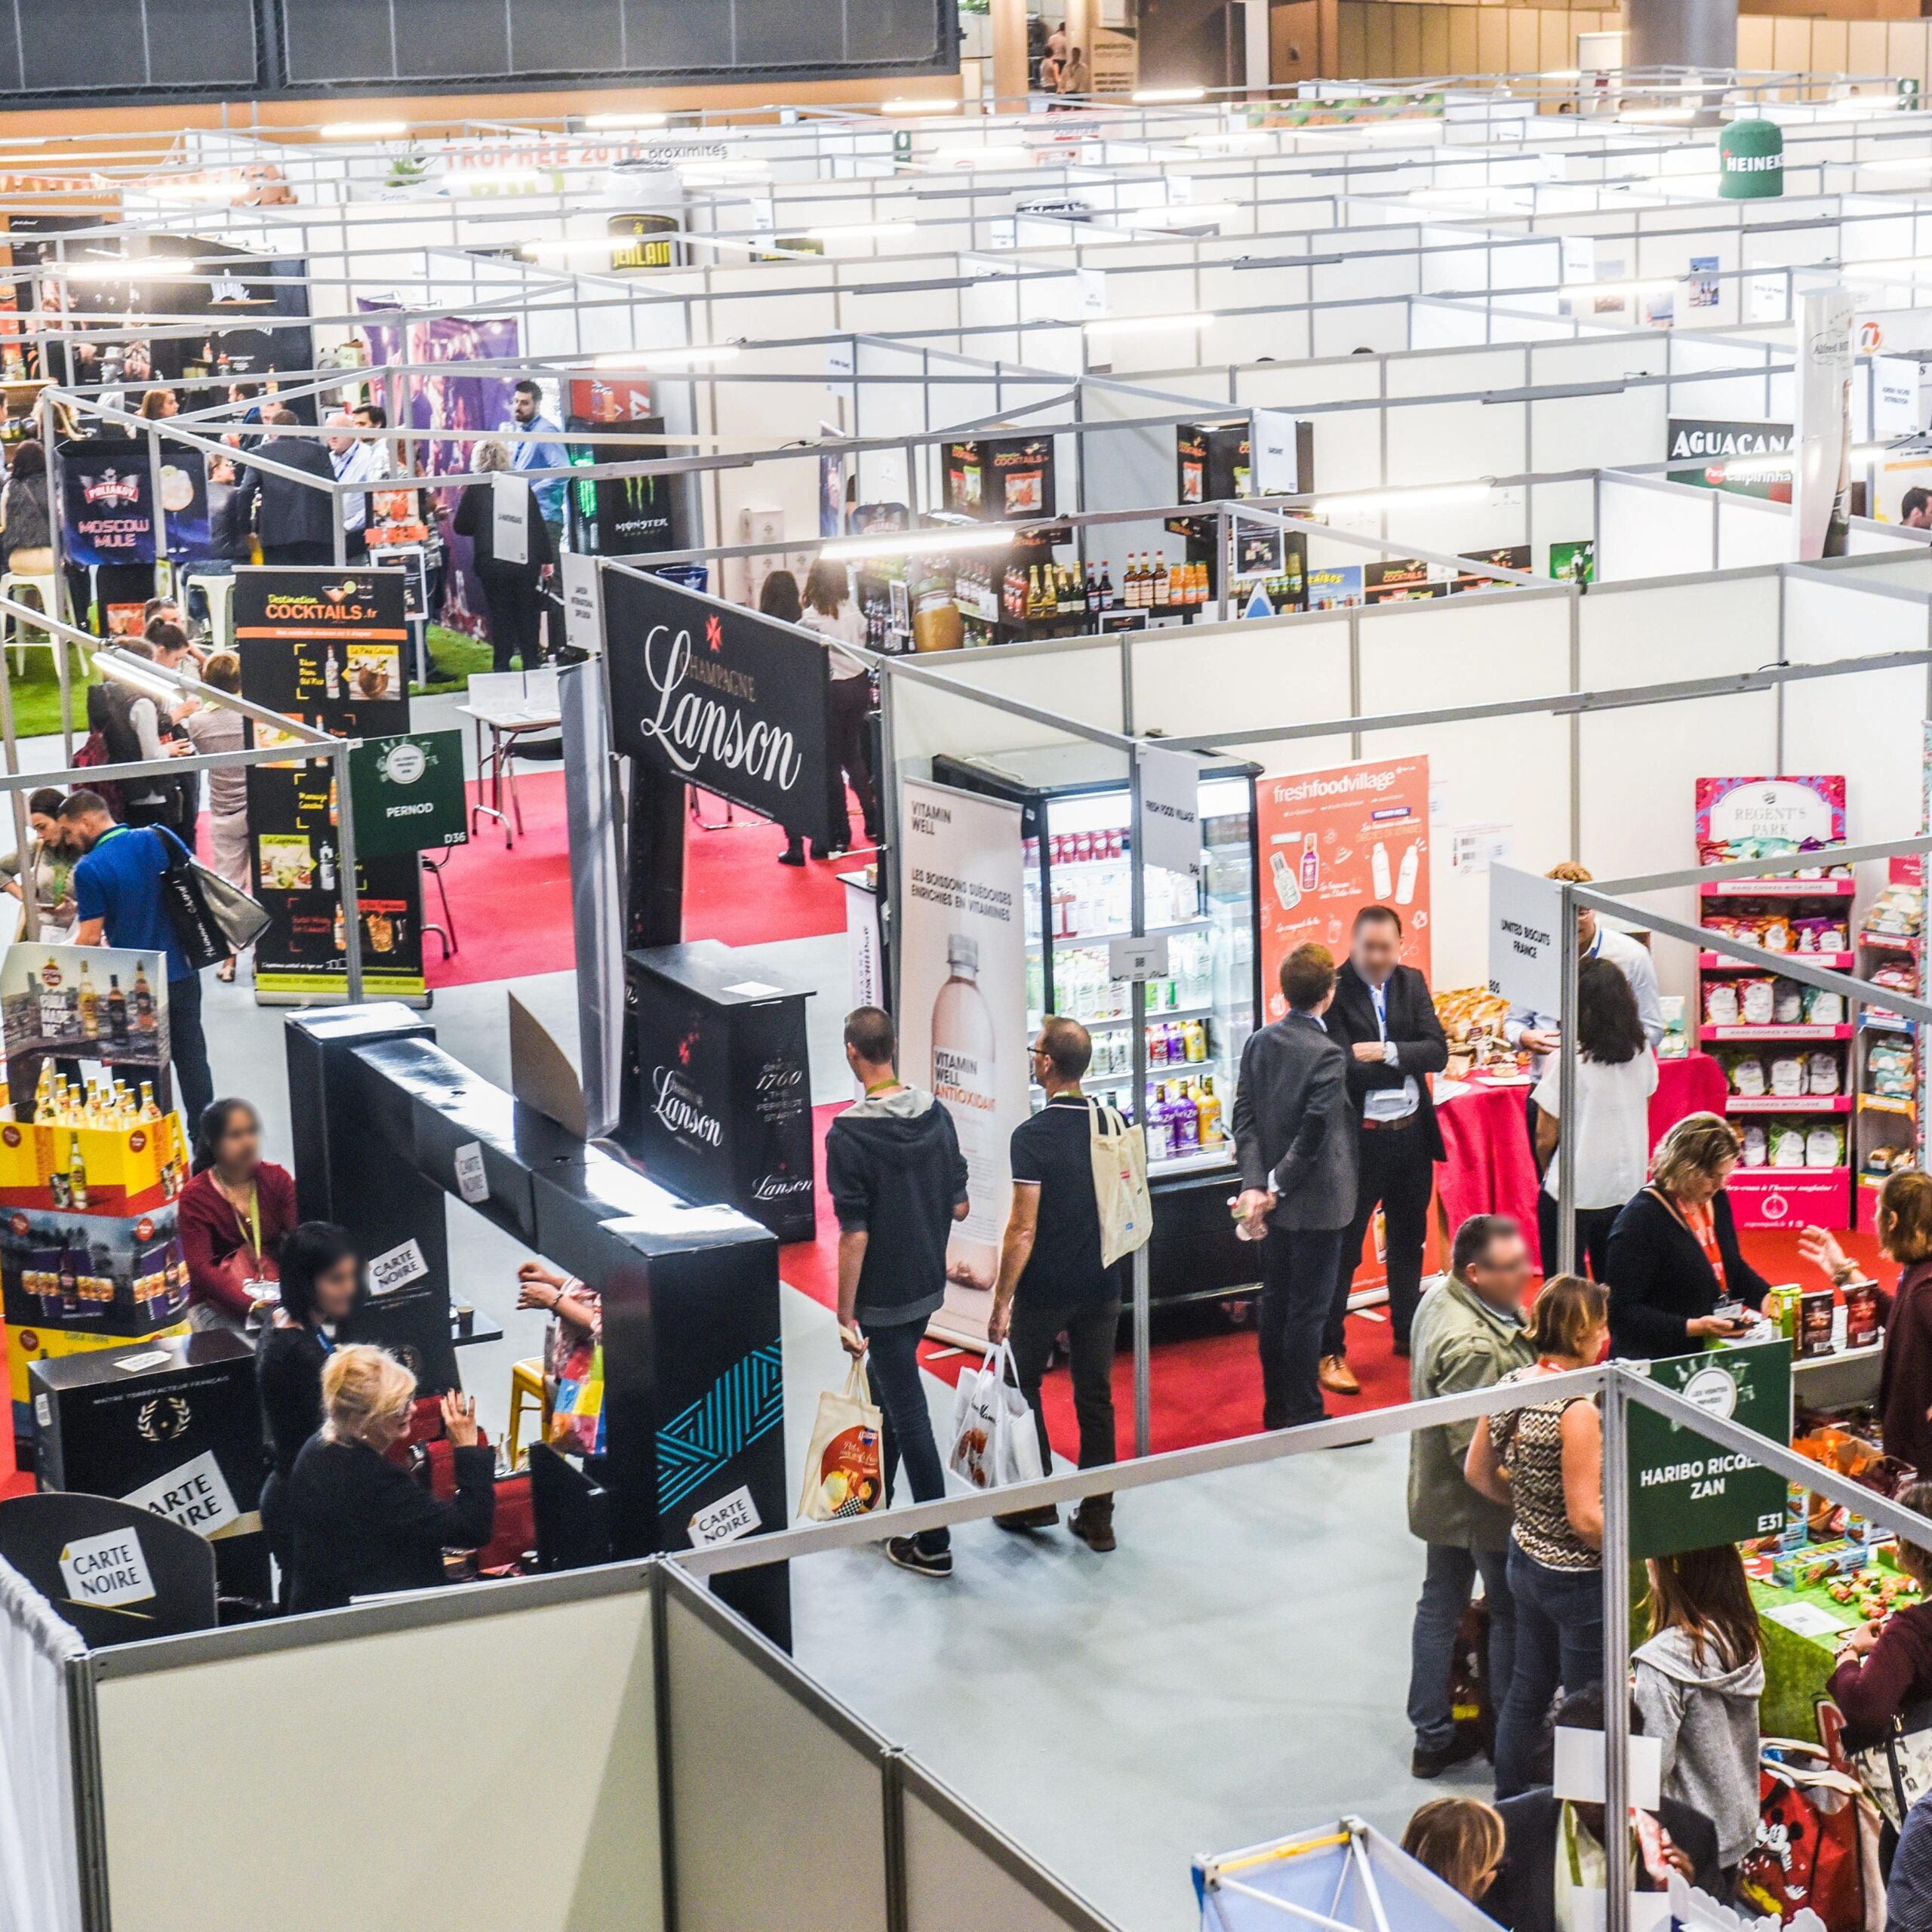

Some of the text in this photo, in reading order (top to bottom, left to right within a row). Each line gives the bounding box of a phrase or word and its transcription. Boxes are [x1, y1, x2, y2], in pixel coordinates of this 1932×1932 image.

[78, 518, 150, 534] MOSCOW
[615, 518, 669, 531] MONSTER
[94, 534, 137, 548] MULE
[641, 625, 802, 791] Lanson
[1273, 771, 1395, 804] freshfoodvillage
[386, 803, 434, 817] PERNOD
[911, 801, 952, 823] VITAMIN
[445, 832, 466, 844] D36
[911, 819, 935, 835] WELL
[1752, 823, 1789, 836] PARK
[911, 868, 924, 882] LES
[926, 871, 967, 894] BOISSONS
[911, 884, 1011, 921] ENRICHIES EN VITAMINES
[1513, 940, 1537, 958] FRANCE
[934, 1050, 978, 1075] VITAMIN
[755, 1070, 802, 1091] 1760
[935, 1067, 961, 1086] WELL
[651, 1066, 723, 1147] Lanson
[752, 1174, 814, 1200] Lanson
[373, 1249, 415, 1277] CARTE
[378, 1260, 421, 1289] NOIRE
[1640, 1454, 1762, 1487] HARIBO RICQL
[148, 1474, 212, 1515] ARTE
[1690, 1478, 1725, 1500] ZAN
[698, 1497, 747, 1531] CARTE
[1758, 1512, 1783, 1533] E31
[704, 1510, 751, 1544] NOIRE
[73, 1544, 134, 1575] CARTE
[81, 1567, 141, 1598] NOIRE
